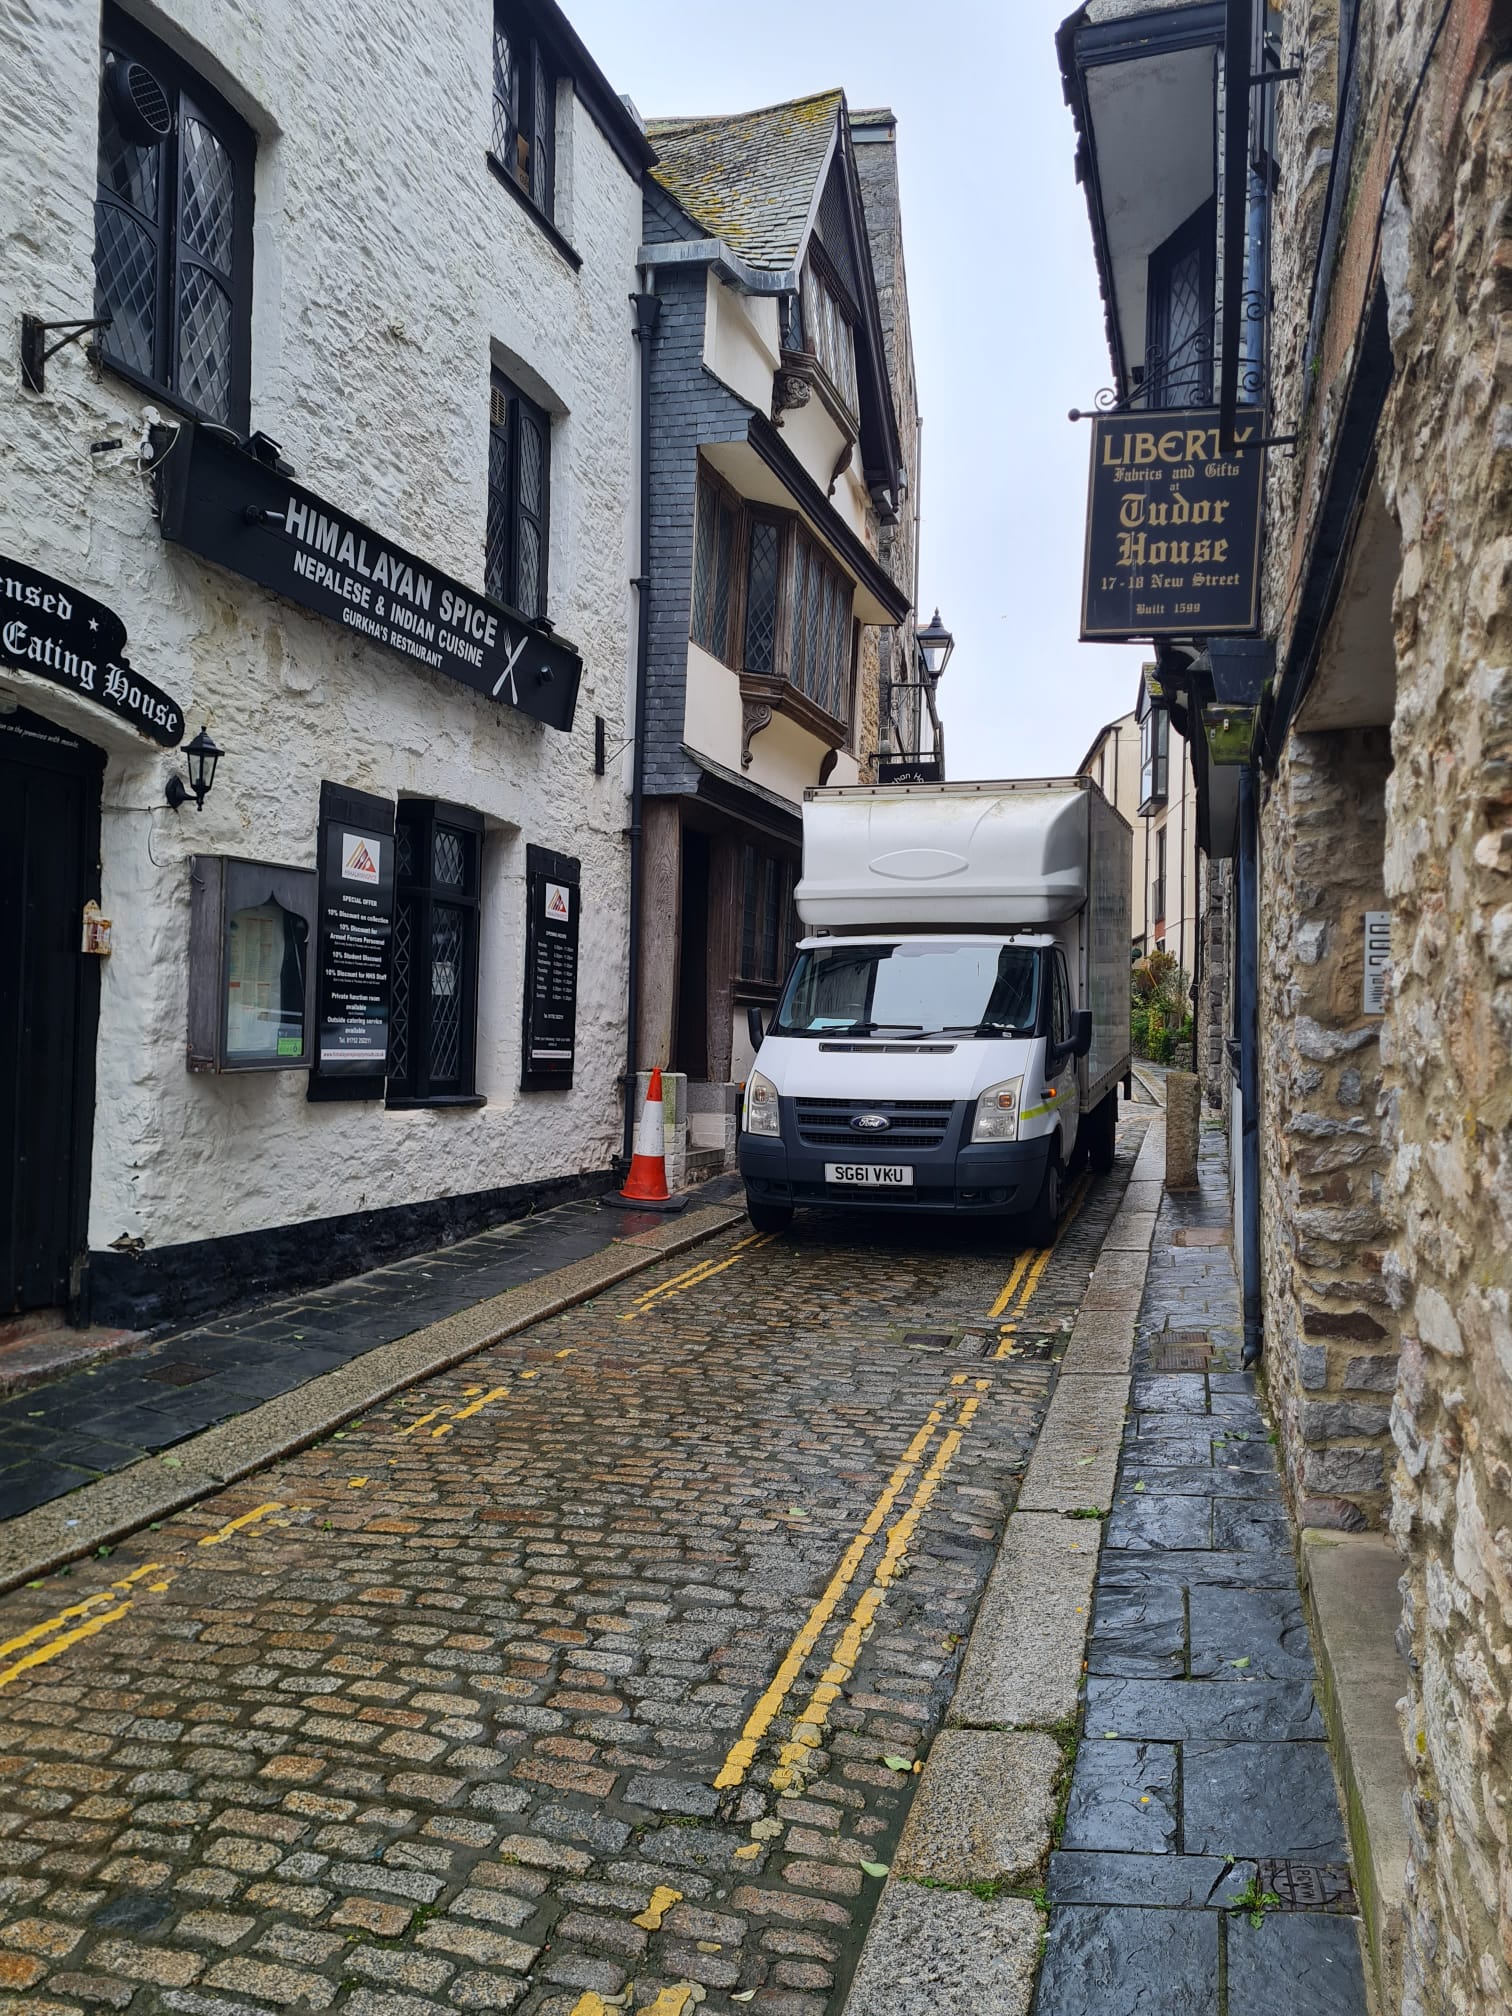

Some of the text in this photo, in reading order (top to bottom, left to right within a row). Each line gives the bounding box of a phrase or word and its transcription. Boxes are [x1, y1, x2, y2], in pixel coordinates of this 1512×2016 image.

[1102, 426, 1255, 466] LIBERTY
[1113, 463, 1240, 483] Fabrics and Gifts
[1169, 483, 1180, 491] at
[1119, 493, 1231, 528] Tudor
[1116, 532, 1229, 566] House
[285, 497, 499, 648] HIMALAYAN SPICE
[1151, 574, 1184, 589] New
[1192, 572, 1240, 587] Street
[0, 577, 73, 621] nsed
[293, 550, 485, 668] NEPALESE & INDIAN CUISINE
[1136, 602, 1202, 616] Built 1599
[342, 606, 444, 668] GURKHA'S RESTAURANT
[2, 619, 178, 733] Eating House
[342, 895, 377, 907] SPECIAL OFFER
[339, 911, 360, 919] Discount
[367, 914, 389, 924] collection
[350, 925, 370, 933] Discount
[337, 970, 357, 978] Discount
[331, 992, 348, 1000] Private
[349, 993, 368, 1001] function
[327, 1016, 346, 1024] Outside
[859, 1118, 881, 1127] Ford
[835, 1166, 904, 1183] SG61 VKU
